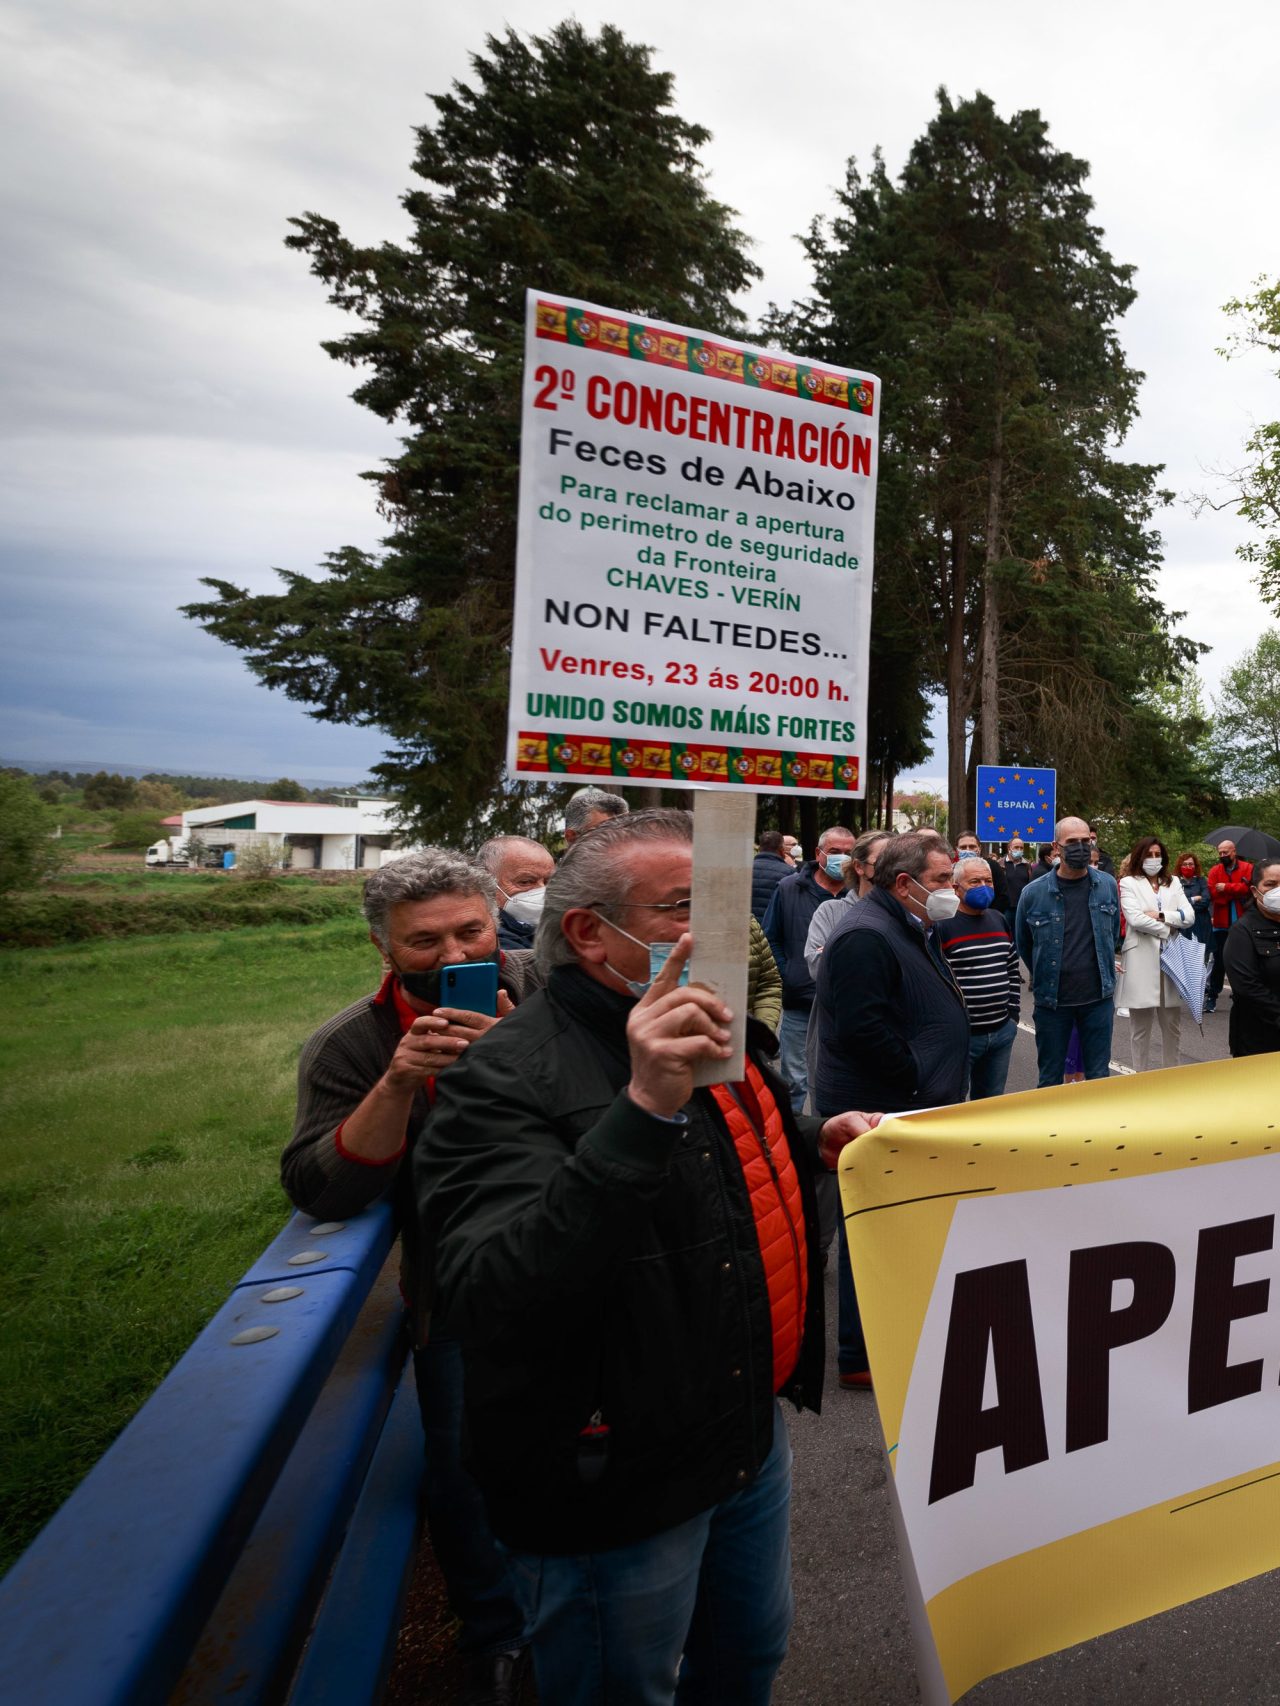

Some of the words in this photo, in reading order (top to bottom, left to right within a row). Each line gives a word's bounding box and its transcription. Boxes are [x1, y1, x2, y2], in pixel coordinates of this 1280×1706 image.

[533, 364, 576, 412] 2º
[586, 375, 872, 477] CONCENTRACIÓN
[549, 427, 667, 476] Feces
[680, 455, 725, 487] de
[734, 465, 856, 511] Abaixo
[538, 501, 572, 523] do
[580, 511, 698, 545] perimetro
[705, 526, 733, 550] de
[740, 538, 859, 570] seguridade
[560, 474, 617, 505] Para
[626, 491, 730, 523] reclamar
[735, 511, 748, 526] a
[755, 515, 845, 543] apertura
[606, 567, 709, 600] CHAVES
[731, 585, 801, 613] VERÍN
[637, 545, 666, 567] da
[674, 550, 777, 583] Fronteira
[545, 598, 629, 633] NON
[644, 611, 847, 660] FALTEDES...
[539, 647, 654, 686] Venres,
[664, 661, 698, 686] 23
[708, 665, 740, 690] ás
[748, 671, 820, 699] 20:00
[828, 679, 849, 702] h.
[526, 692, 605, 722] UNIDO
[612, 699, 704, 730] SOMOS
[710, 704, 771, 736] MÁIS
[777, 715, 856, 743] FORTES
[997, 800, 1036, 809] ESPAÑA
